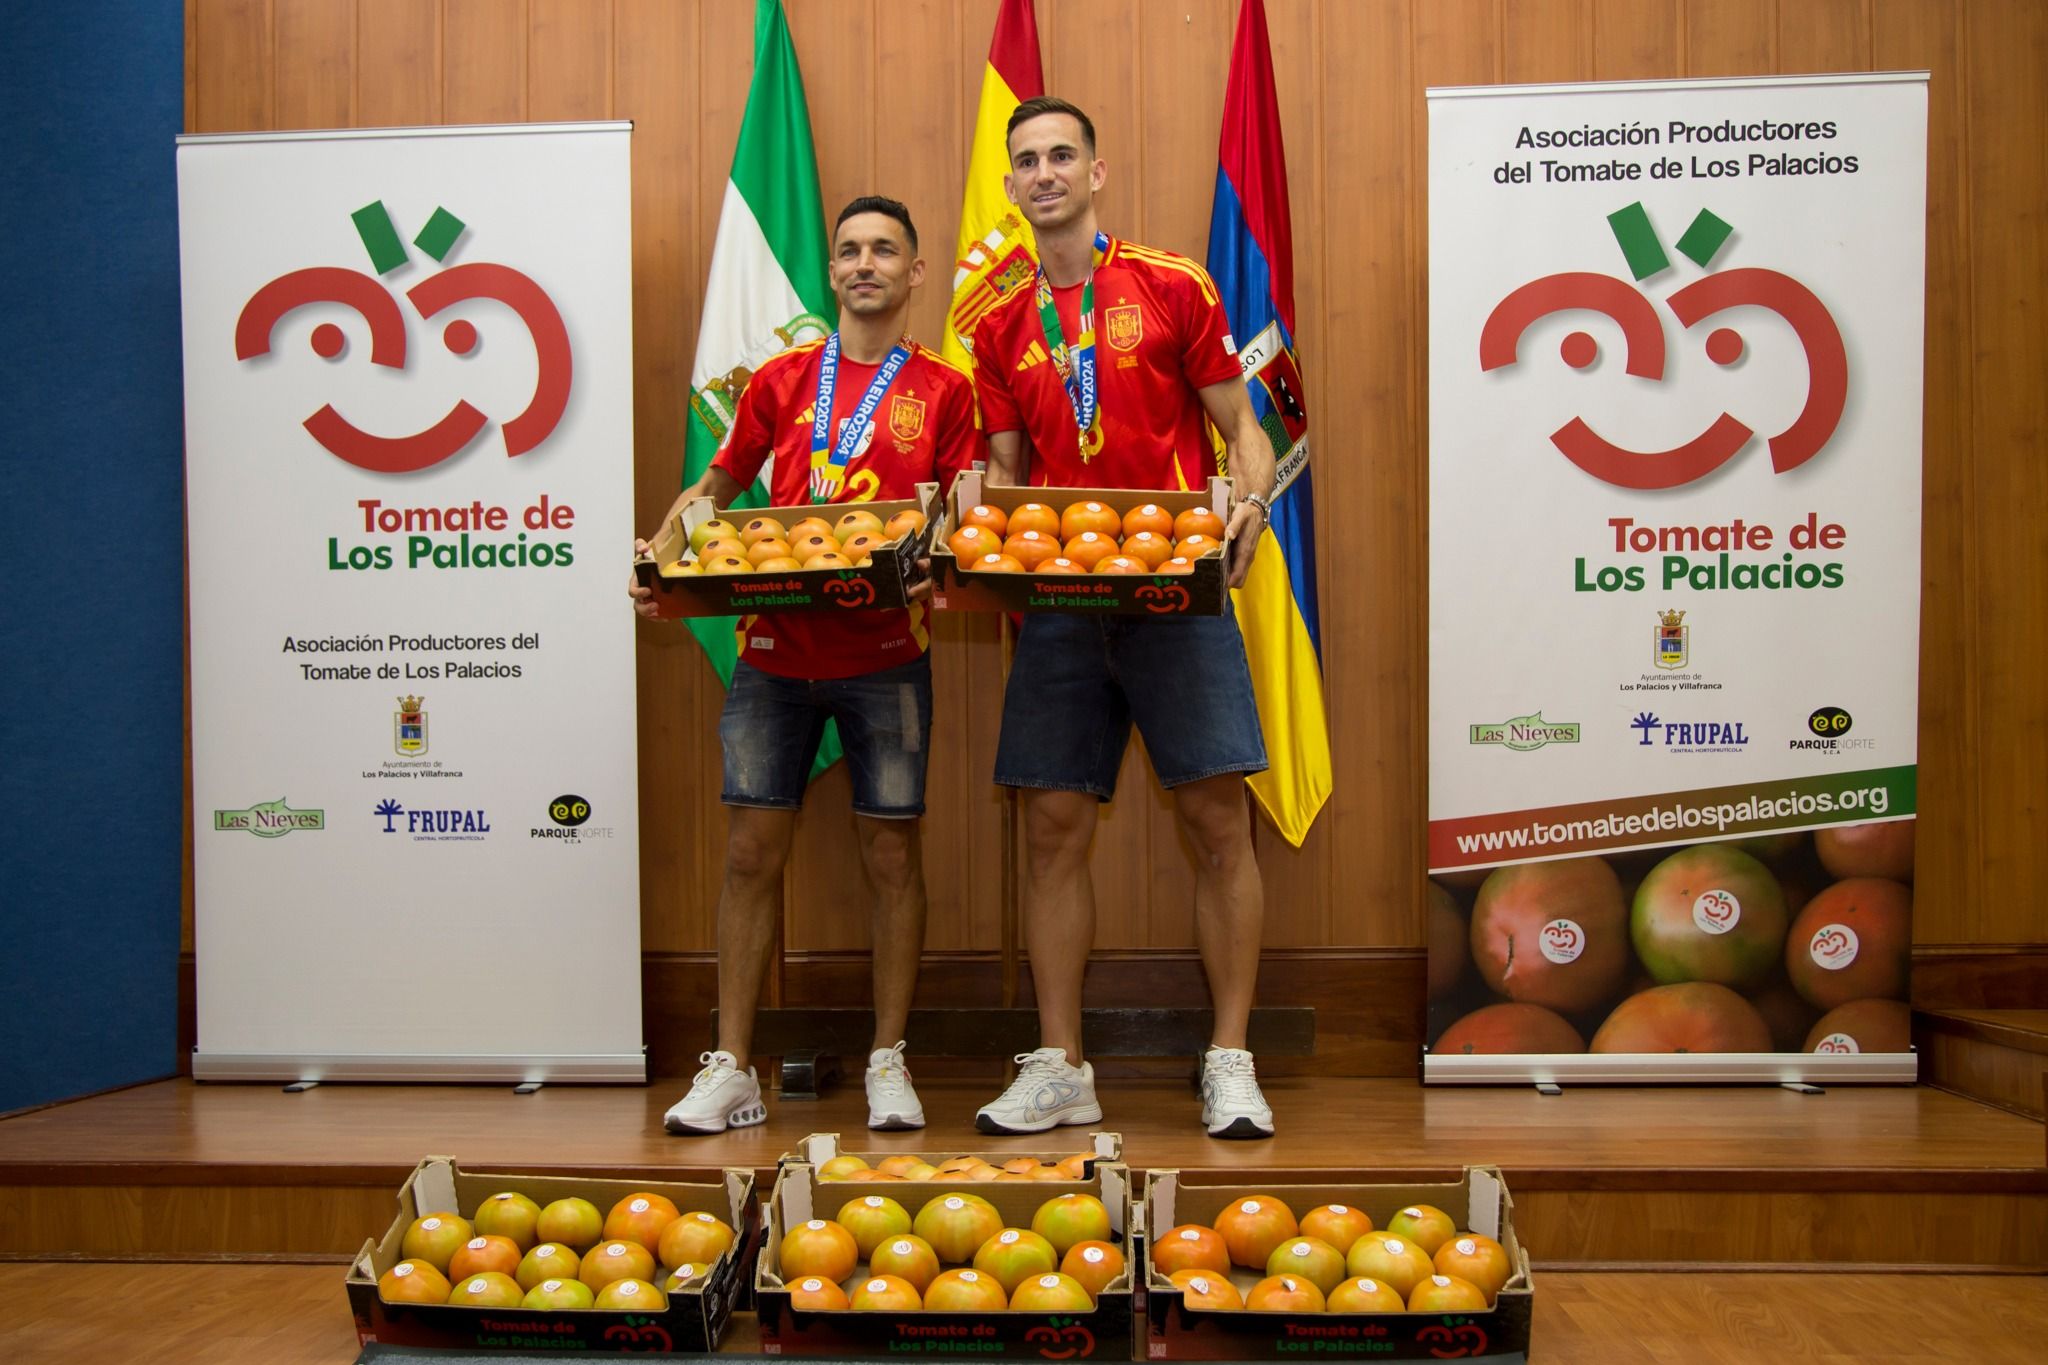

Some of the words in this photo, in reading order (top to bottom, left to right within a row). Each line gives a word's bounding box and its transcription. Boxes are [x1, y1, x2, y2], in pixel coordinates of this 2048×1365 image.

[1516, 121, 1659, 148] Asociación
[1669, 120, 1837, 143] Productores
[1494, 161, 1531, 184] del
[1540, 160, 1641, 182] Tomate
[1650, 157, 1683, 179] de
[1692, 156, 1740, 178] Los
[1749, 152, 1859, 176] Palacios
[357, 499, 508, 532] Tomate
[524, 494, 575, 530] de
[1608, 517, 1774, 553] Tomate
[1789, 512, 1847, 550] de
[329, 538, 392, 570] Los
[408, 533, 574, 570] Palacios
[1575, 558, 1645, 592] Los
[1662, 552, 1845, 591] Palacios
[731, 581, 783, 593] Tomate
[785, 579, 802, 590] de
[1034, 583, 1091, 593] Tomate
[1094, 583, 1113, 593] de
[730, 596, 753, 606] Los
[755, 593, 812, 606] Palacios
[1029, 596, 1055, 606] Los
[1057, 595, 1120, 607] Palacios
[283, 635, 383, 652] Asociación
[389, 634, 506, 651] Productores
[512, 633, 538, 649] del
[300, 664, 371, 680] Tomate
[377, 663, 400, 679] de
[406, 663, 439, 679] Los
[445, 662, 522, 678] Palacios
[1641, 674, 1690, 682] Ayuntamiento
[1637, 683, 1670, 691] Palacios
[1474, 726, 1504, 741] Las
[1510, 723, 1574, 741] Nieves
[1665, 723, 1748, 745] FRUPAL
[382, 761, 432, 770] Ayuntamiento
[219, 812, 249, 828] Las
[255, 810, 319, 828] Nieves
[408, 810, 490, 832] FRUPAL
[1456, 786, 1889, 854] www.tomatedelospalacios.org
[481, 1320, 549, 1333] Tomate
[553, 1321, 576, 1333] de
[896, 1324, 968, 1336] Tomate
[972, 1323, 996, 1336] de
[1285, 1324, 1359, 1336] Tomate
[1363, 1324, 1387, 1336] de
[477, 1335, 508, 1345] Los
[511, 1336, 587, 1348] Palacios
[889, 1340, 921, 1352] Los
[925, 1338, 1005, 1352] Palacios
[1276, 1340, 1309, 1352] Los
[1313, 1338, 1395, 1352] Palacios
